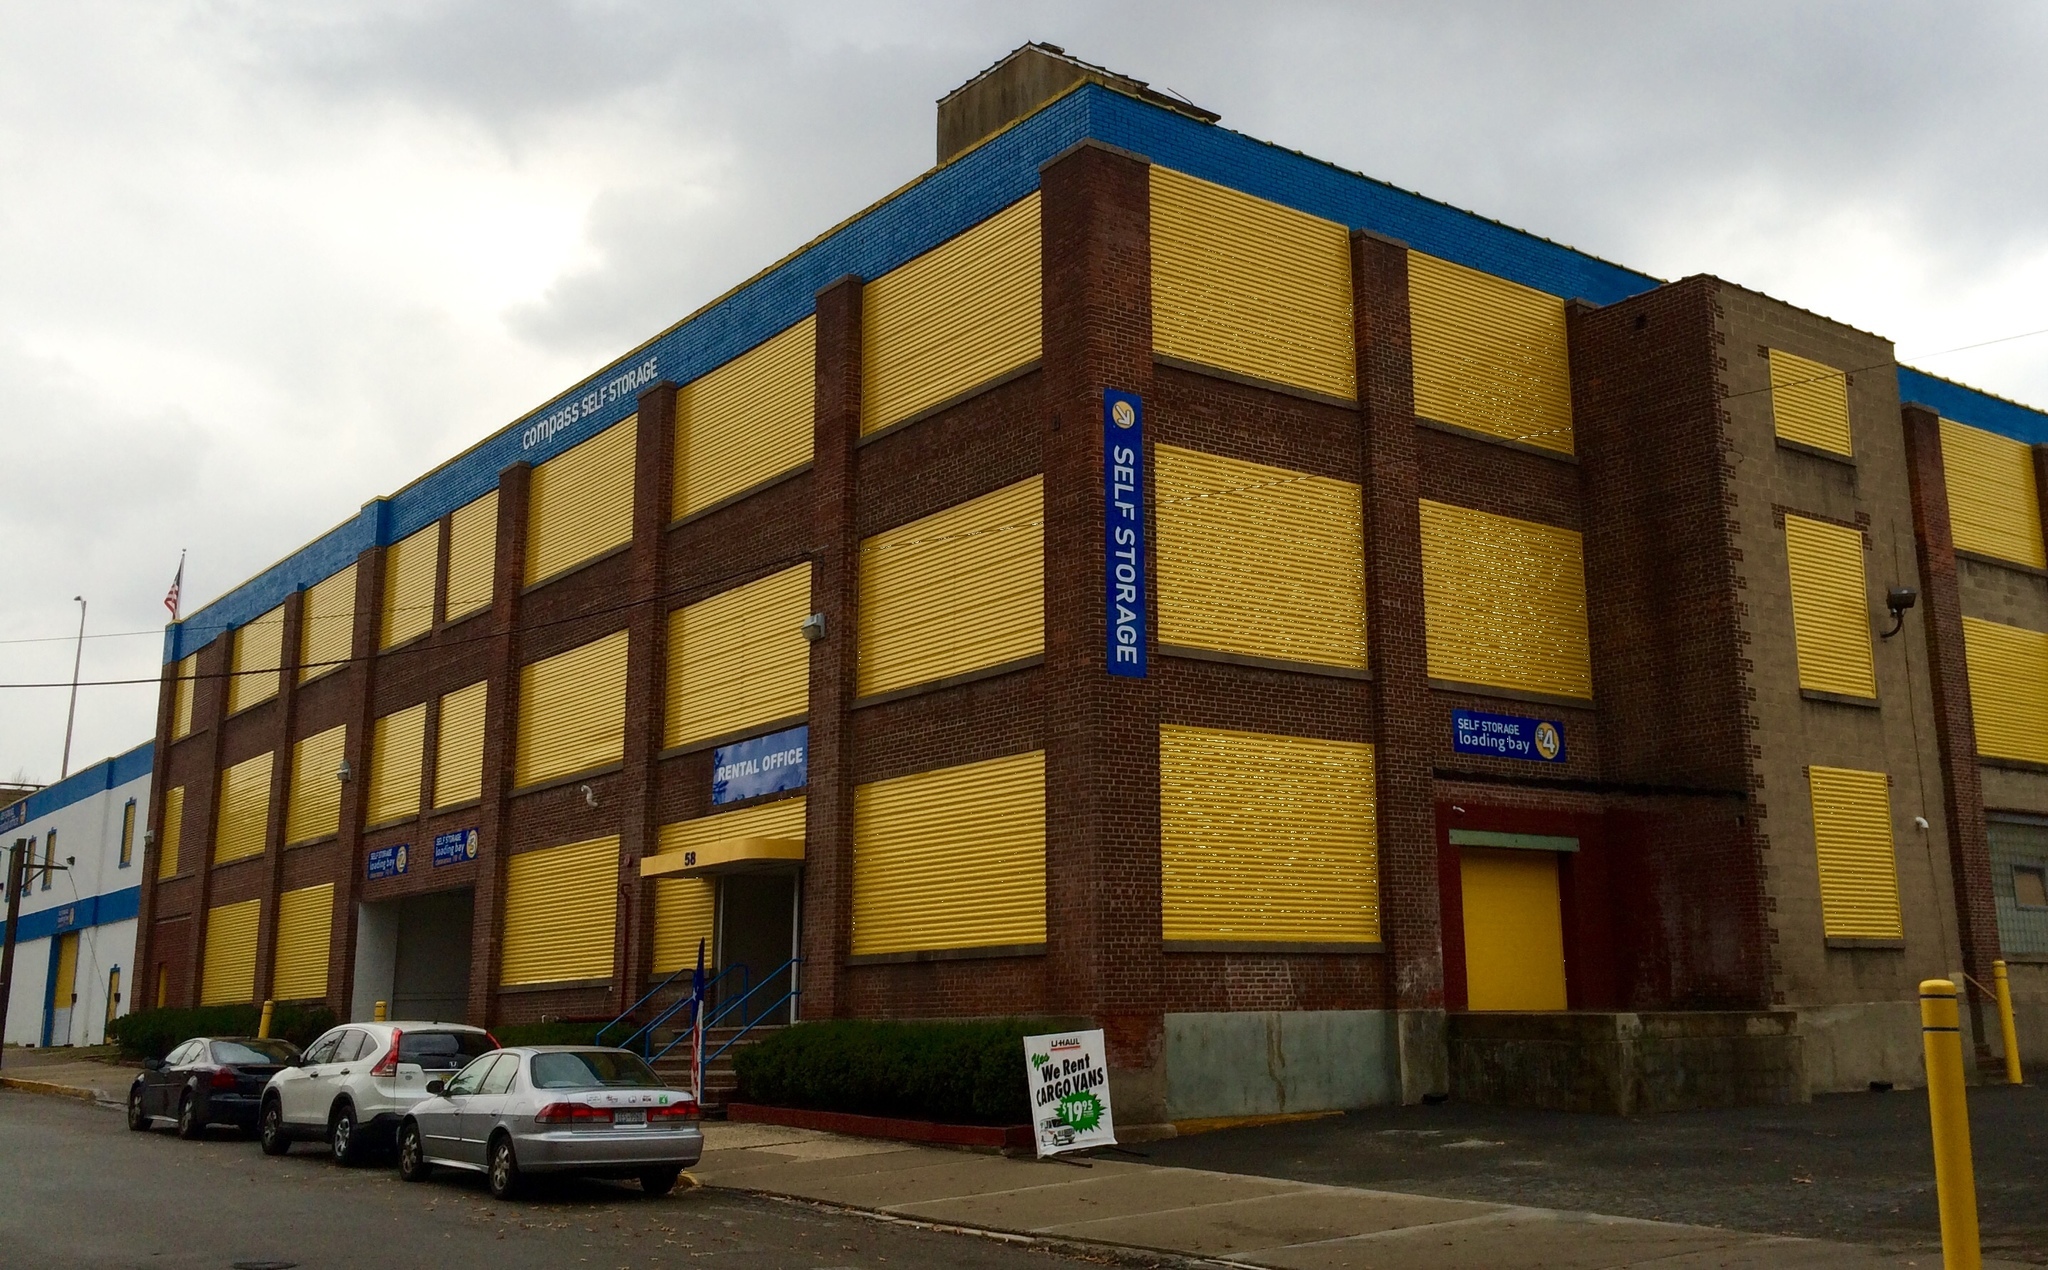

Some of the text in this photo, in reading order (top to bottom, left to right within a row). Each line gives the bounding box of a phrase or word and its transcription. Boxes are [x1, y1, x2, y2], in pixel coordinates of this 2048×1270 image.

[523, 357, 658, 449] compass SELF STORAGE
[1114, 444, 1137, 664] SELF STORAGE
[1458, 718, 1520, 735] SELF STORAGE
[1459, 730, 1530, 754] loading bay
[718, 747, 803, 781] RENTAL OFFICE
[435, 842, 465, 857] loading bay
[684, 851, 696, 866] 58
[1051, 1038, 1080, 1047] U-HAUL
[1042, 1053, 1090, 1082] We Rent
[1036, 1067, 1104, 1107] CARGO VANS
